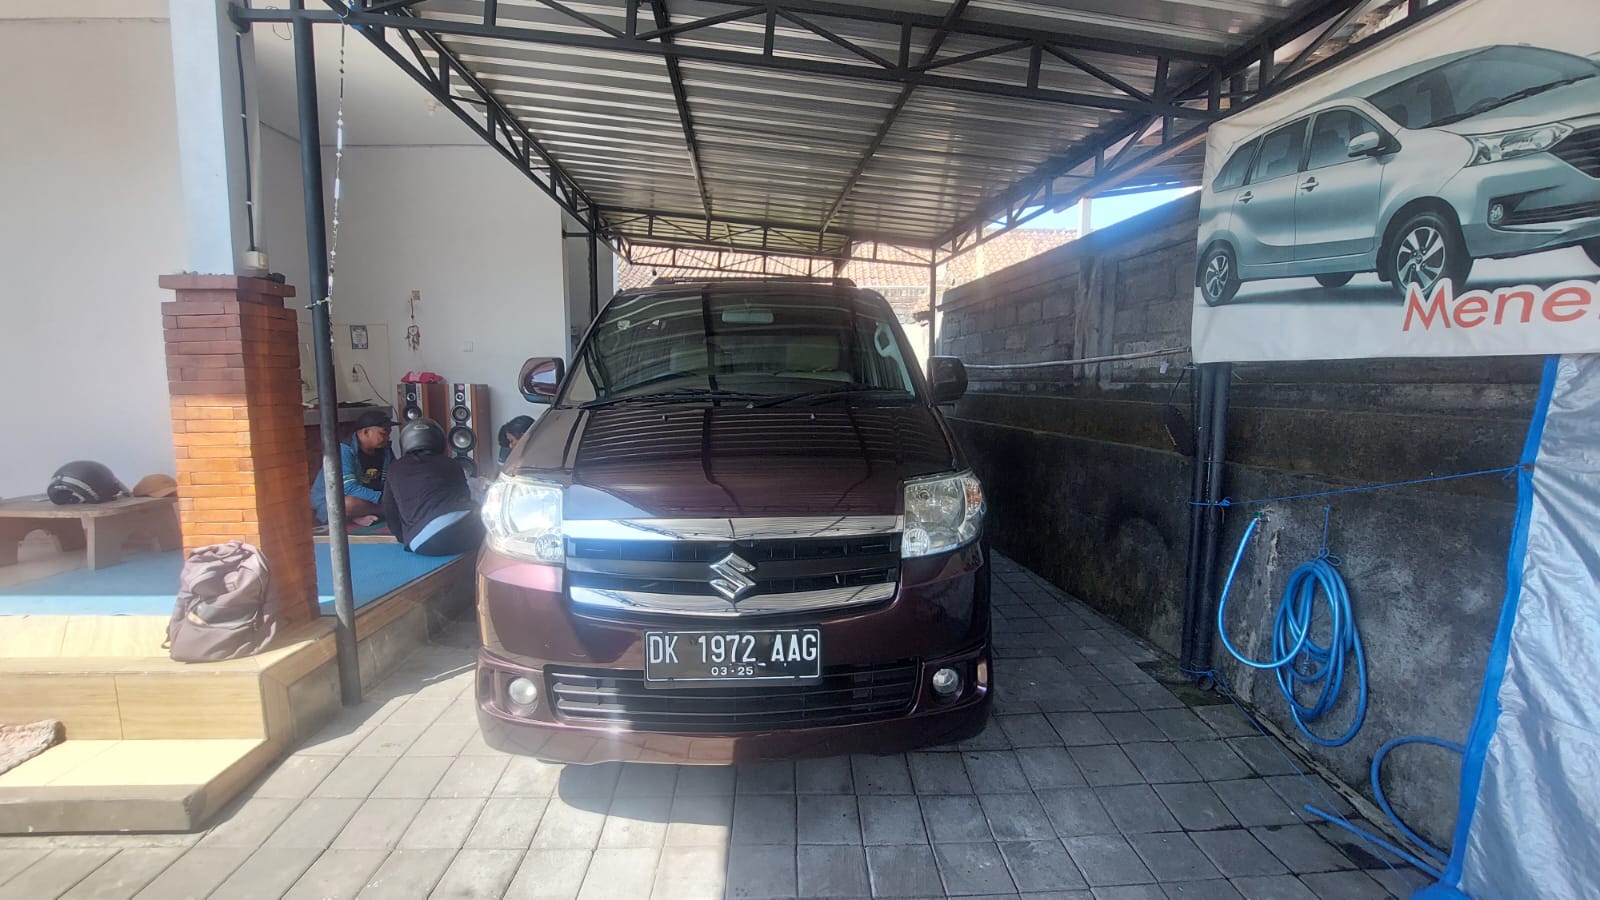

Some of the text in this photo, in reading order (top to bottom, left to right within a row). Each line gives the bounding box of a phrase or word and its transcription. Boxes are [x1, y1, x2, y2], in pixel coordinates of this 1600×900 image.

[1402, 285, 1600, 332] Mene
[649, 633, 817, 664] DK 1972 AAG
